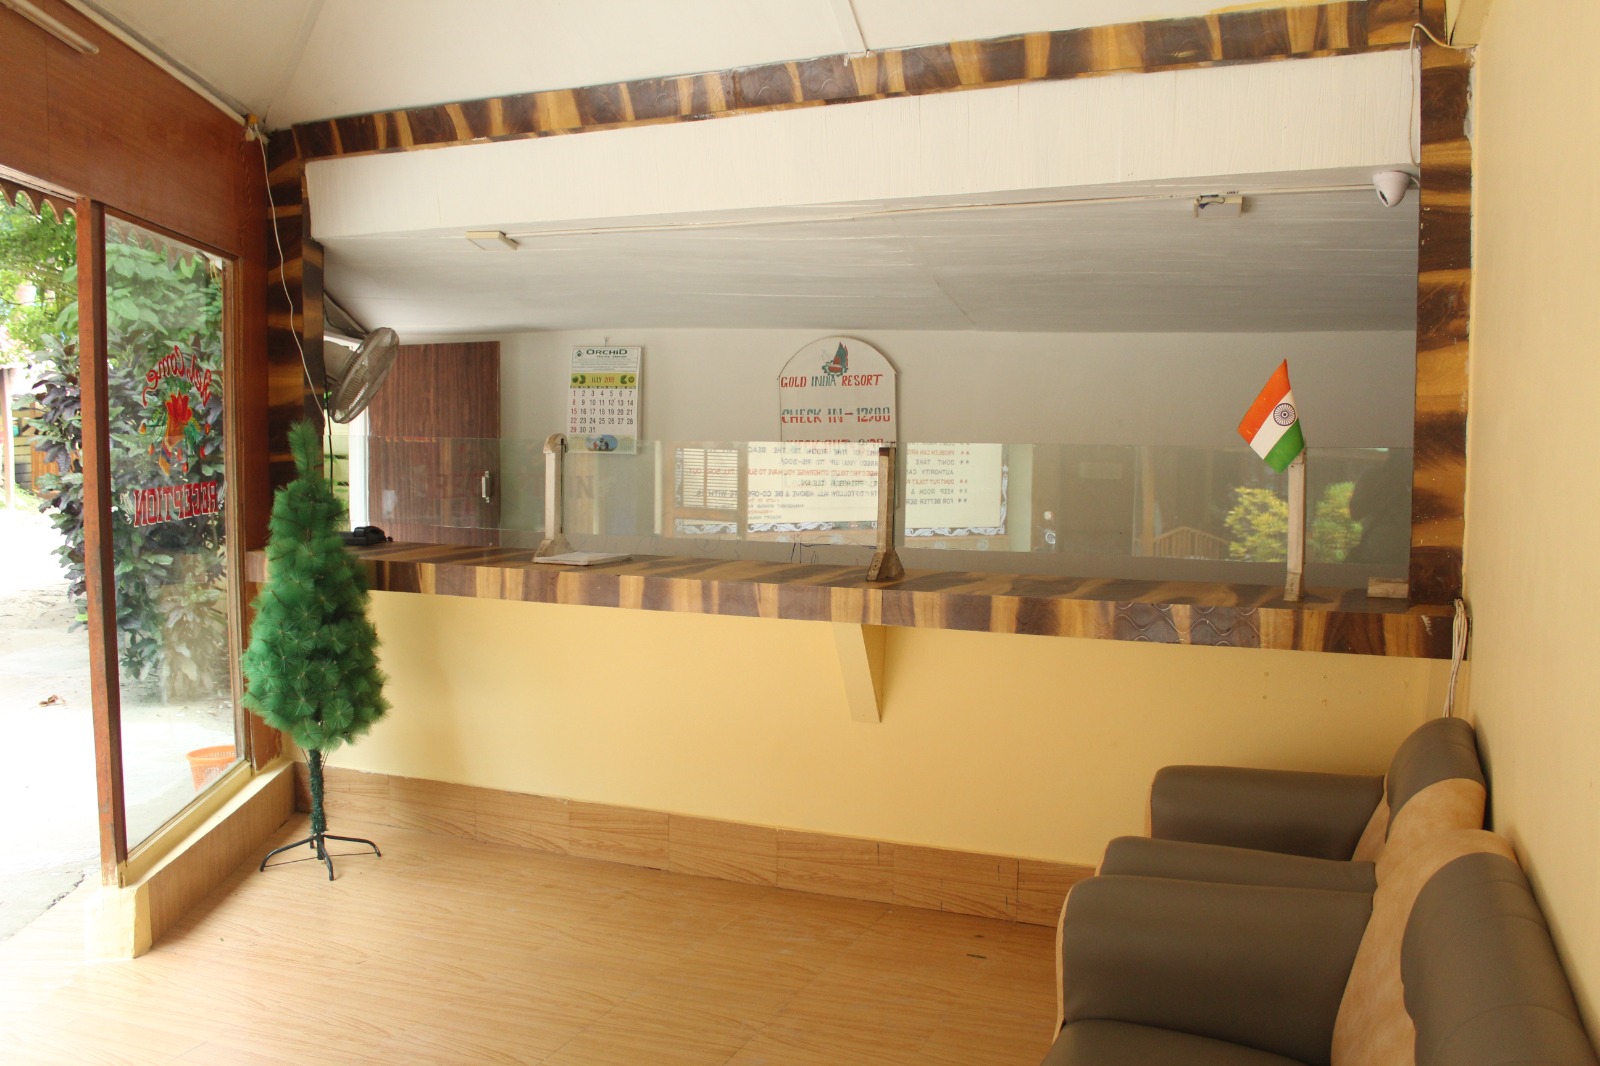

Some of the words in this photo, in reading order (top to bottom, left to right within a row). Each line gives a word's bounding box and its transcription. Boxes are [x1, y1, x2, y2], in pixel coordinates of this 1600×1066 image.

[780, 376, 807, 388] GOLD
[841, 373, 883, 386] RESORT
[781, 408, 822, 424] CHECK
